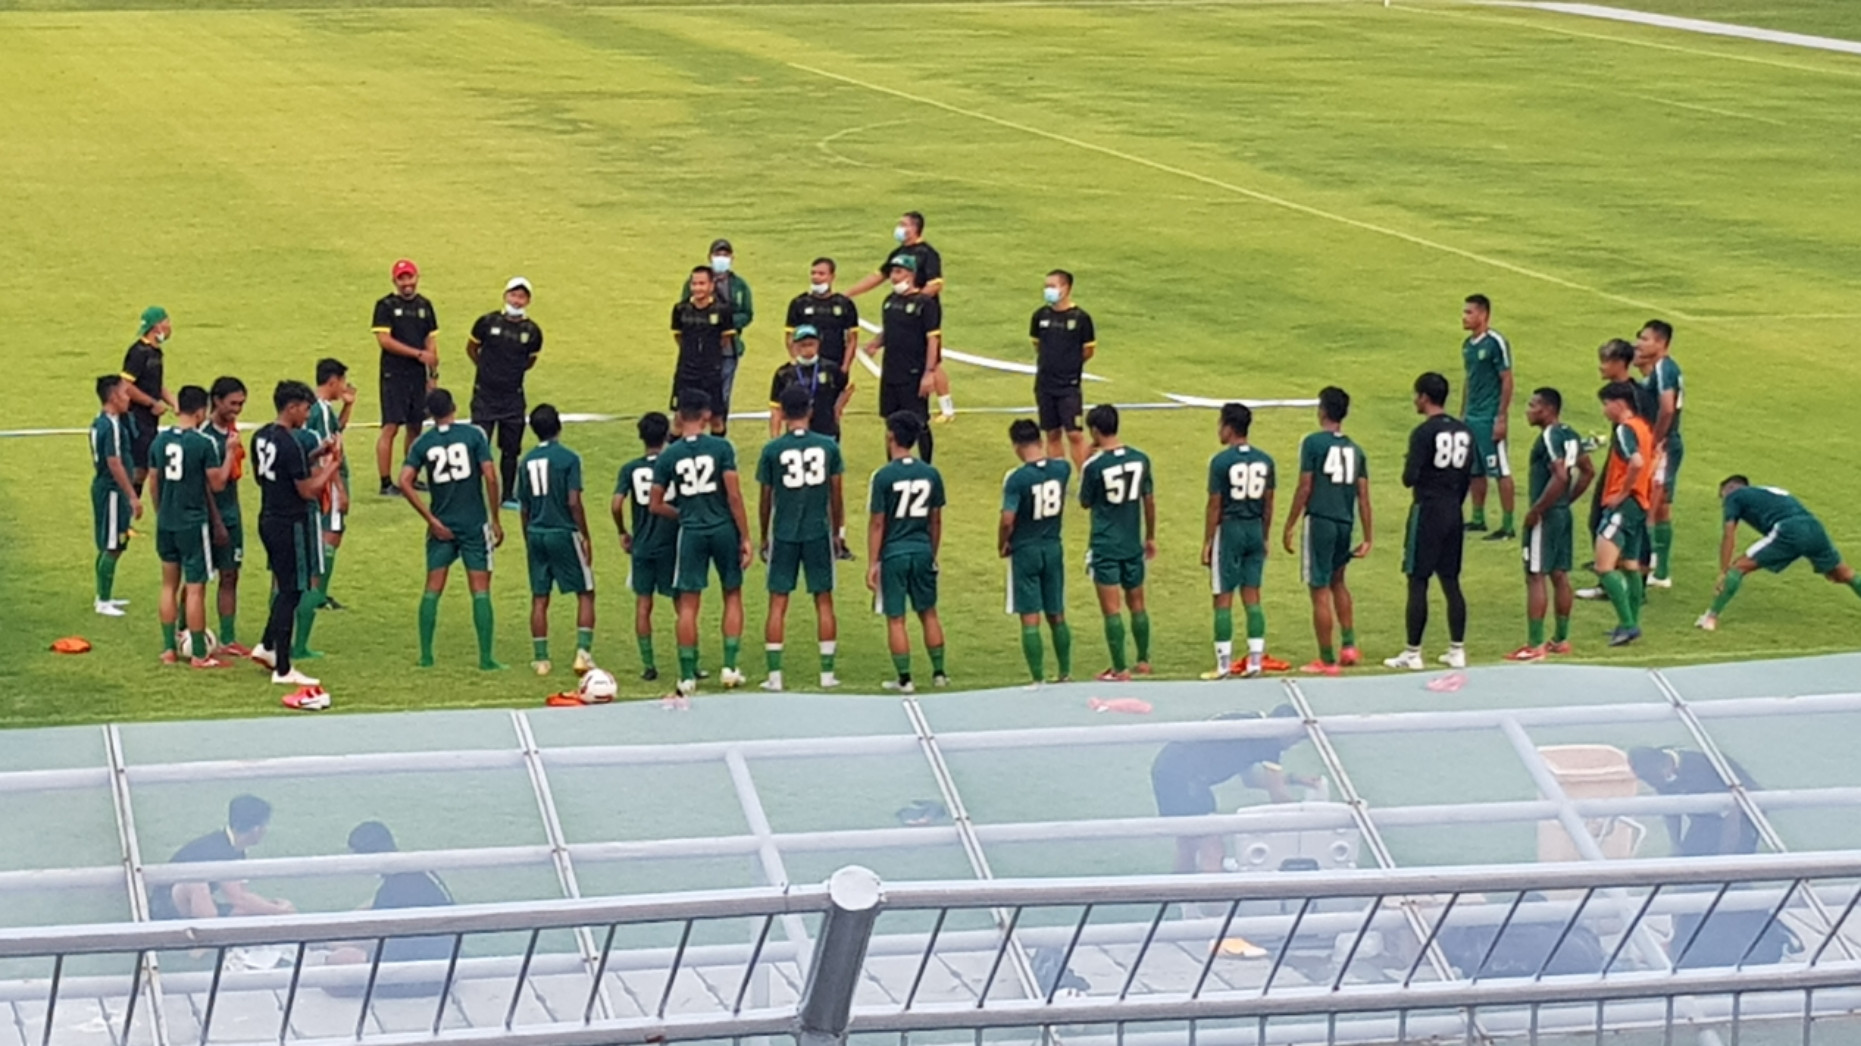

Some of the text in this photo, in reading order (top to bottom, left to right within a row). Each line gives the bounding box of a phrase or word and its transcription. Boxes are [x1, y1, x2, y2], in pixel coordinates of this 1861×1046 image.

[164, 442, 183, 481] 3
[425, 442, 471, 483] 29
[779, 446, 826, 488] 33
[1323, 446, 1356, 484] 41
[1434, 431, 1471, 469] 86
[526, 457, 549, 497] 11
[675, 454, 717, 497] 32
[1102, 460, 1144, 504] 57
[1228, 462, 1268, 501] 96
[892, 478, 933, 518] 72
[1031, 479, 1063, 521] 18
